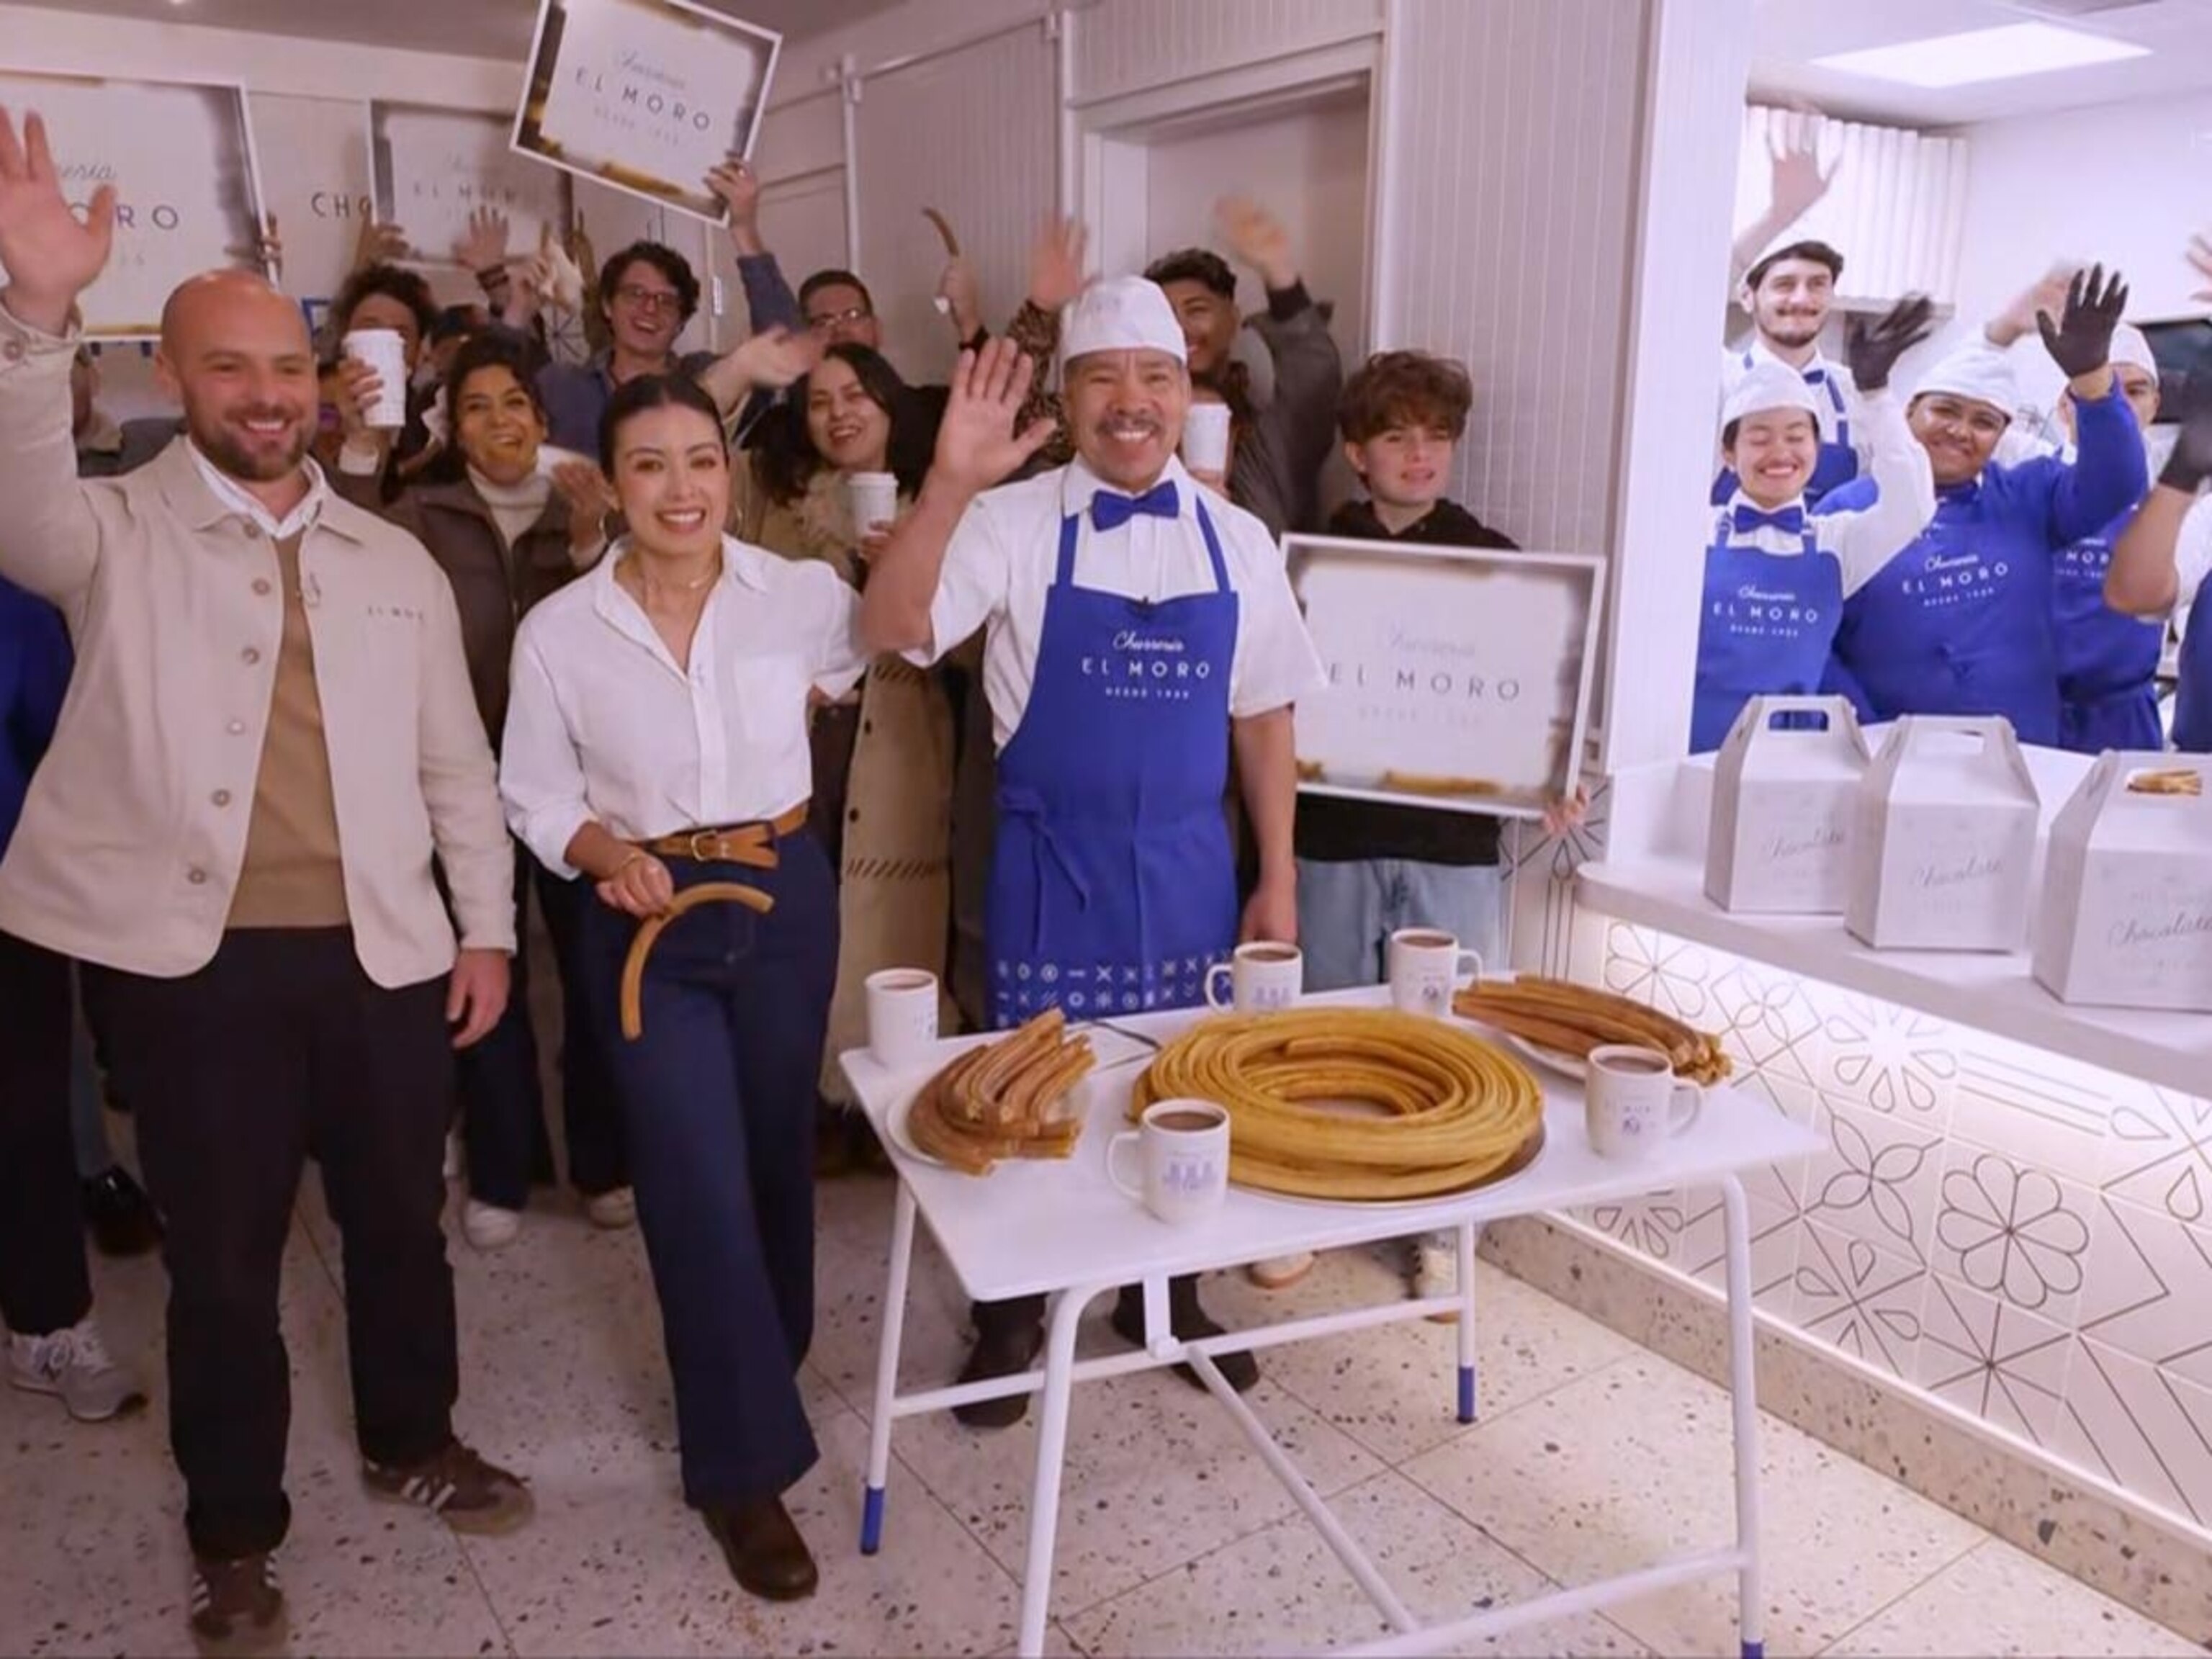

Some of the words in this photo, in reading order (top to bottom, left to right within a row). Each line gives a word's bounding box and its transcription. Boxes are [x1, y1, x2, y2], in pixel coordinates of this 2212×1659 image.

[621, 84, 710, 131] MORO
[1082, 657, 1110, 675] EL
[1128, 661, 1210, 679] MORO
[1395, 668, 1521, 701] MORO
